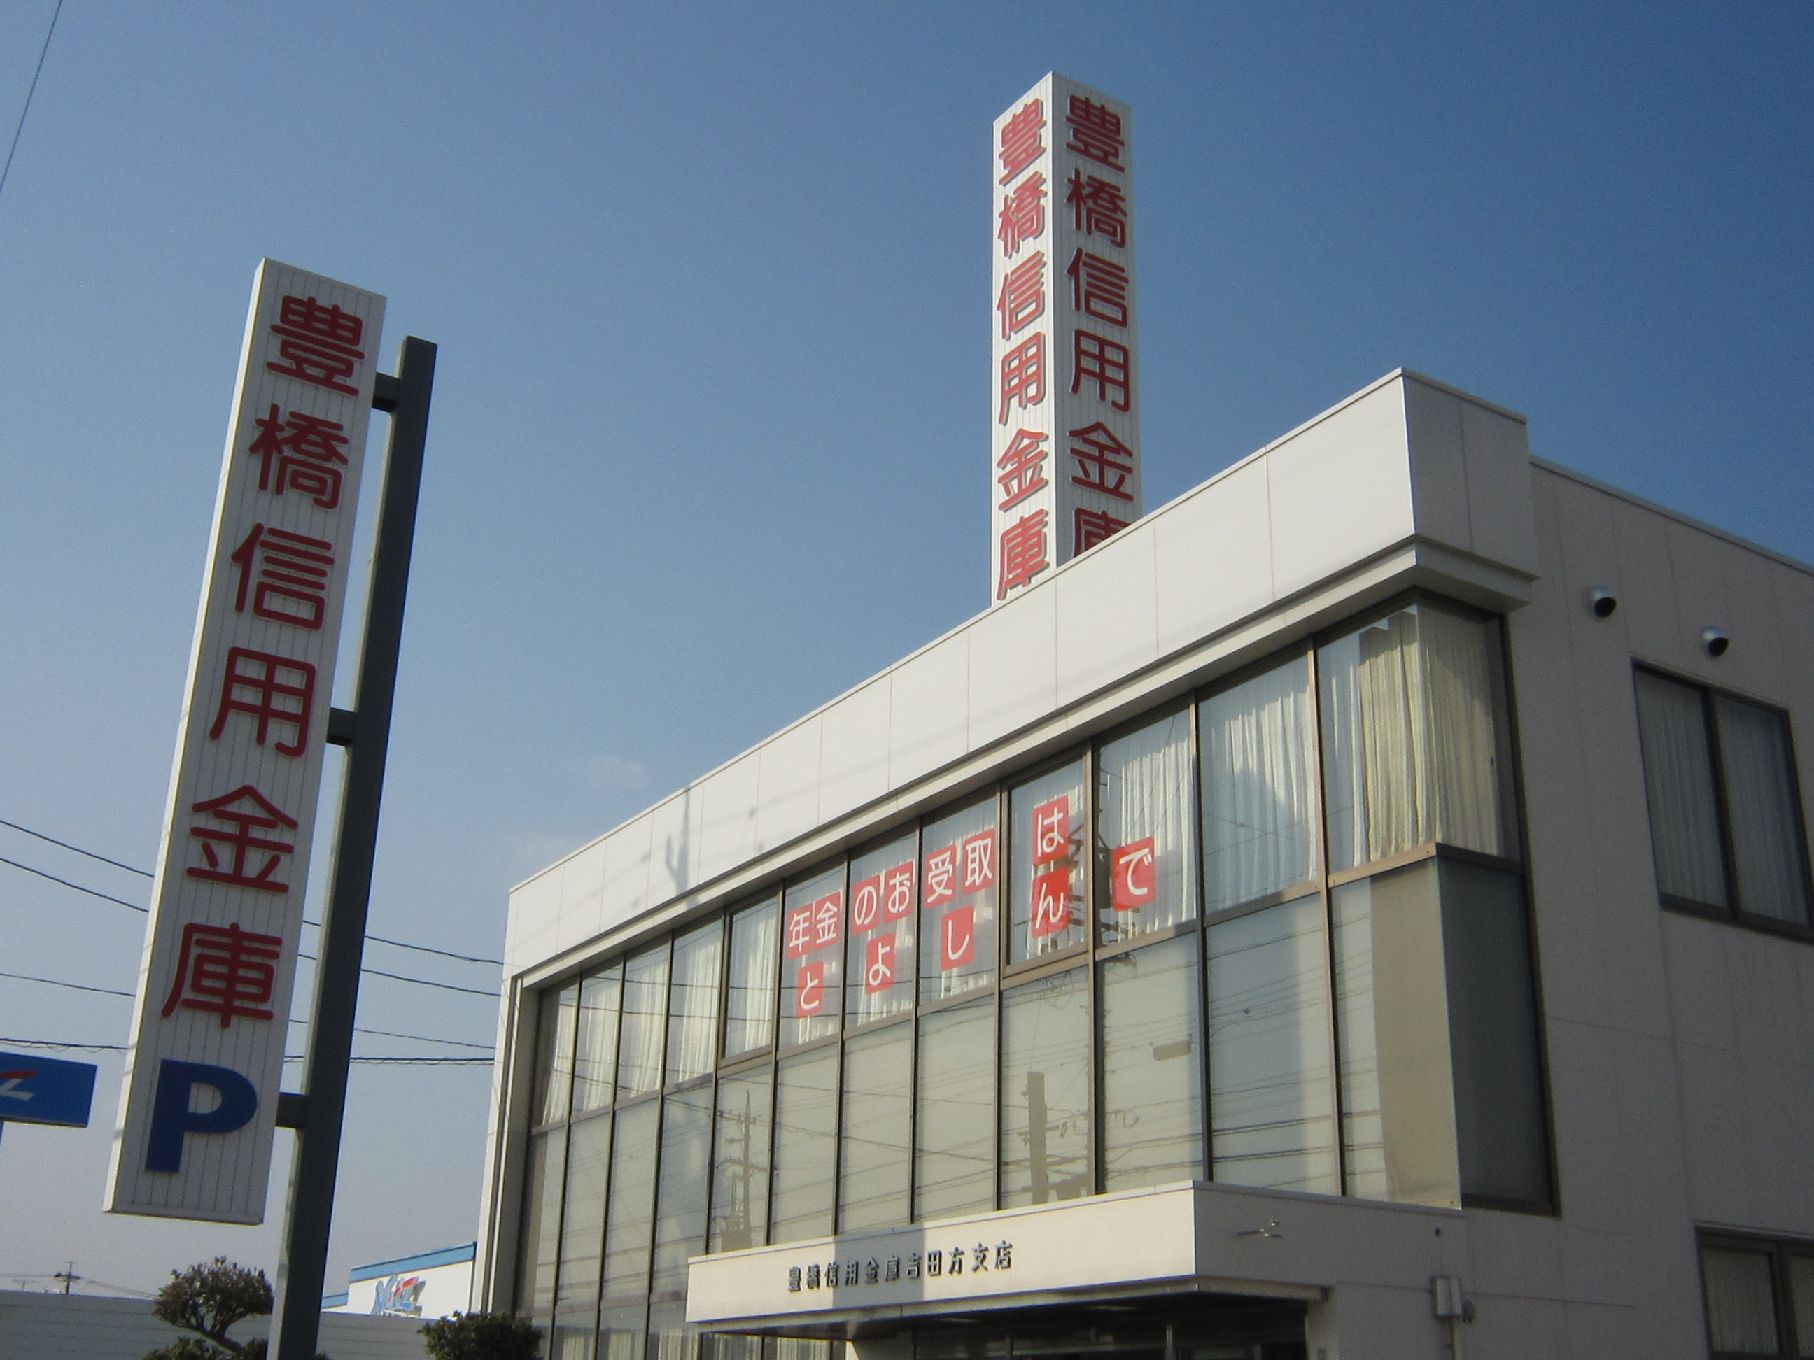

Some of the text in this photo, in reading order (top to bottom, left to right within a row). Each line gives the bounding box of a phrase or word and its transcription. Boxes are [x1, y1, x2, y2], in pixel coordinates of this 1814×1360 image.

[996, 97, 1048, 600] 豊橋信用金庫
[161, 294, 364, 1030] 豊橋信用金庫
[144, 1059, 259, 1174] P
[787, 1239, 1013, 1292] 豊橋信用金庫吉田方支店
